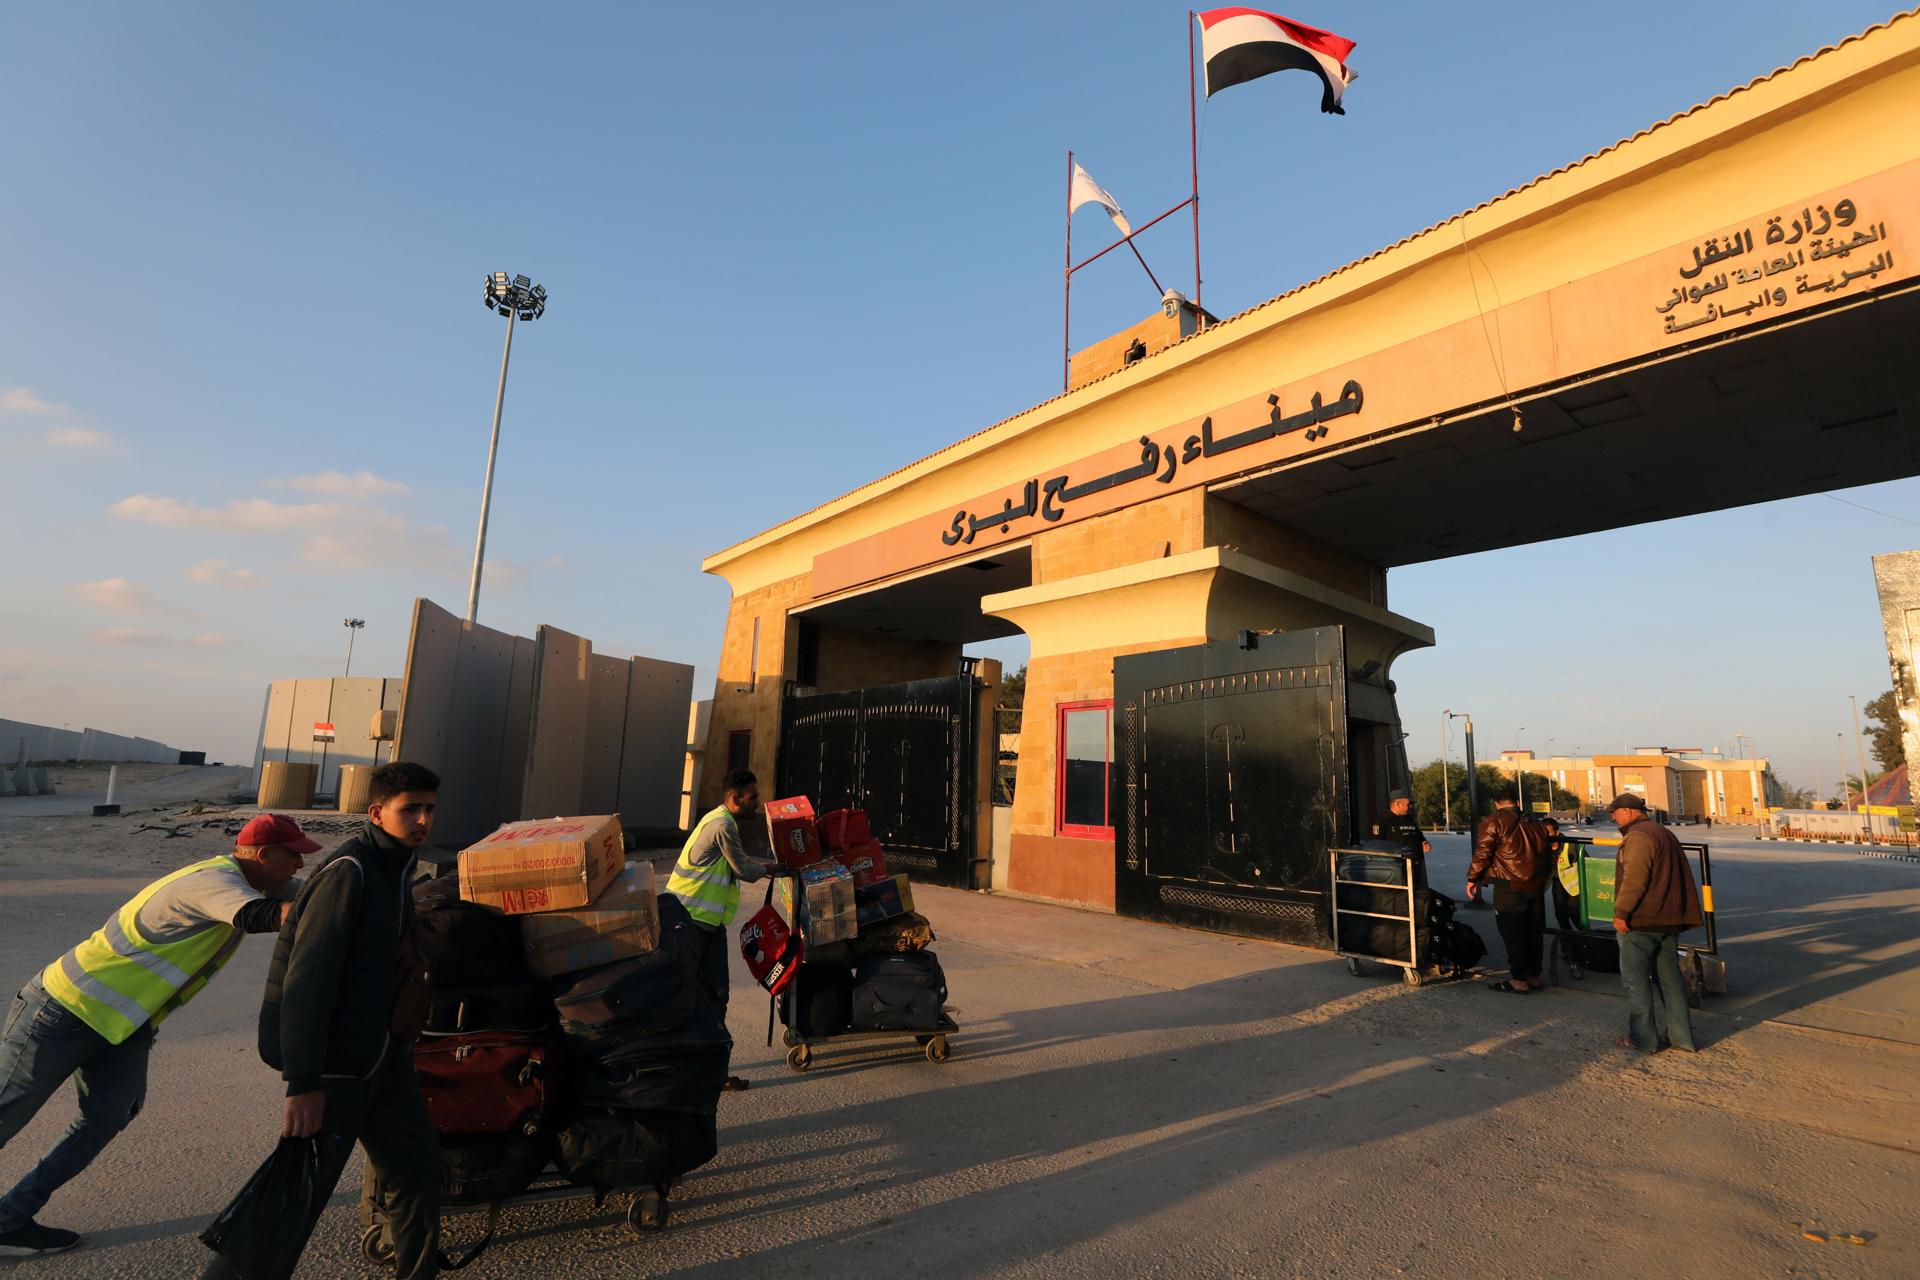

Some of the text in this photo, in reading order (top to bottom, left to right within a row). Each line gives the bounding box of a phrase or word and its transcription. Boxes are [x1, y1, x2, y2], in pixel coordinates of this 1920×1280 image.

[1680, 199, 1857, 279] وزارة النقل
[1730, 248, 1804, 284] العامة
[1809, 221, 1886, 261] الهيئة
[1664, 249, 1894, 334] البرية والجافة
[1181, 379, 1364, 464] ميناء
[1042, 434, 1177, 522] رفح
